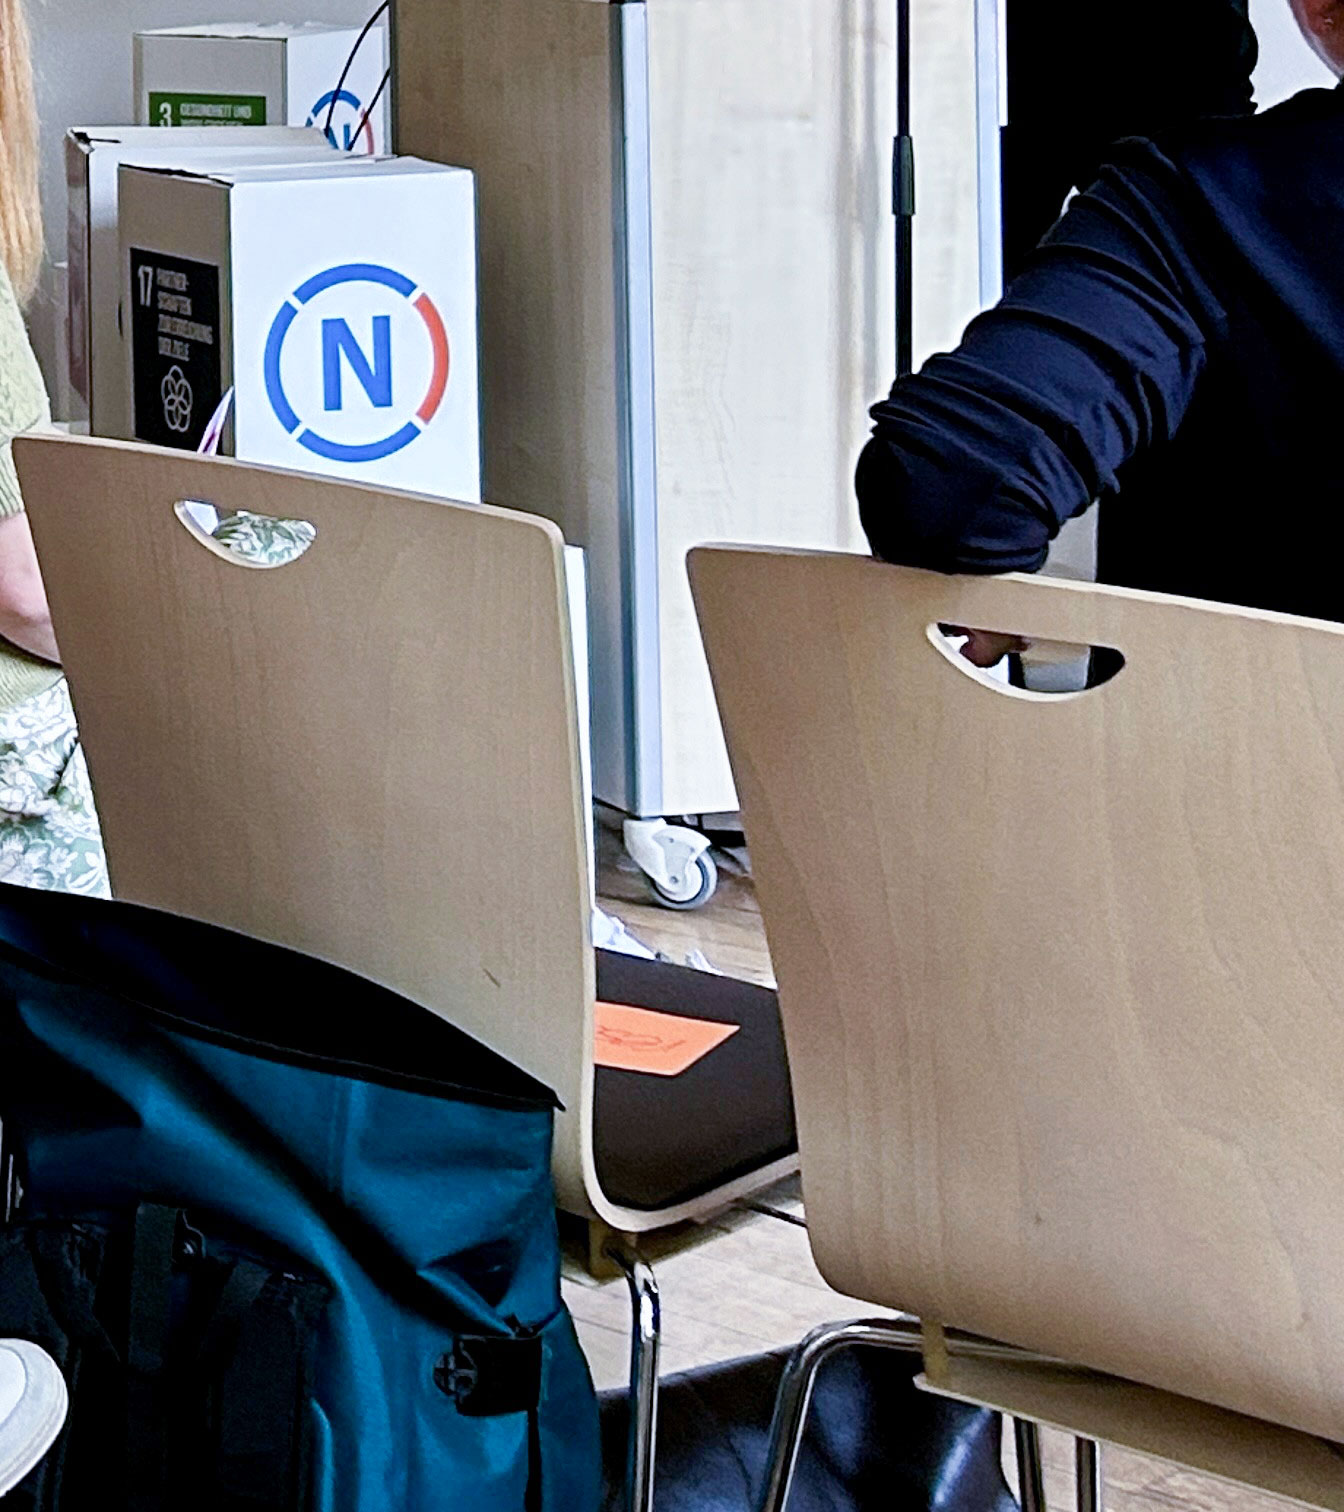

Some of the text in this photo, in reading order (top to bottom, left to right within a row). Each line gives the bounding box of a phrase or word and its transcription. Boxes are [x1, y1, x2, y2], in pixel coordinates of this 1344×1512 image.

[159, 102, 172, 127] 3
[138, 265, 153, 307] 17
[322, 315, 393, 411] N
